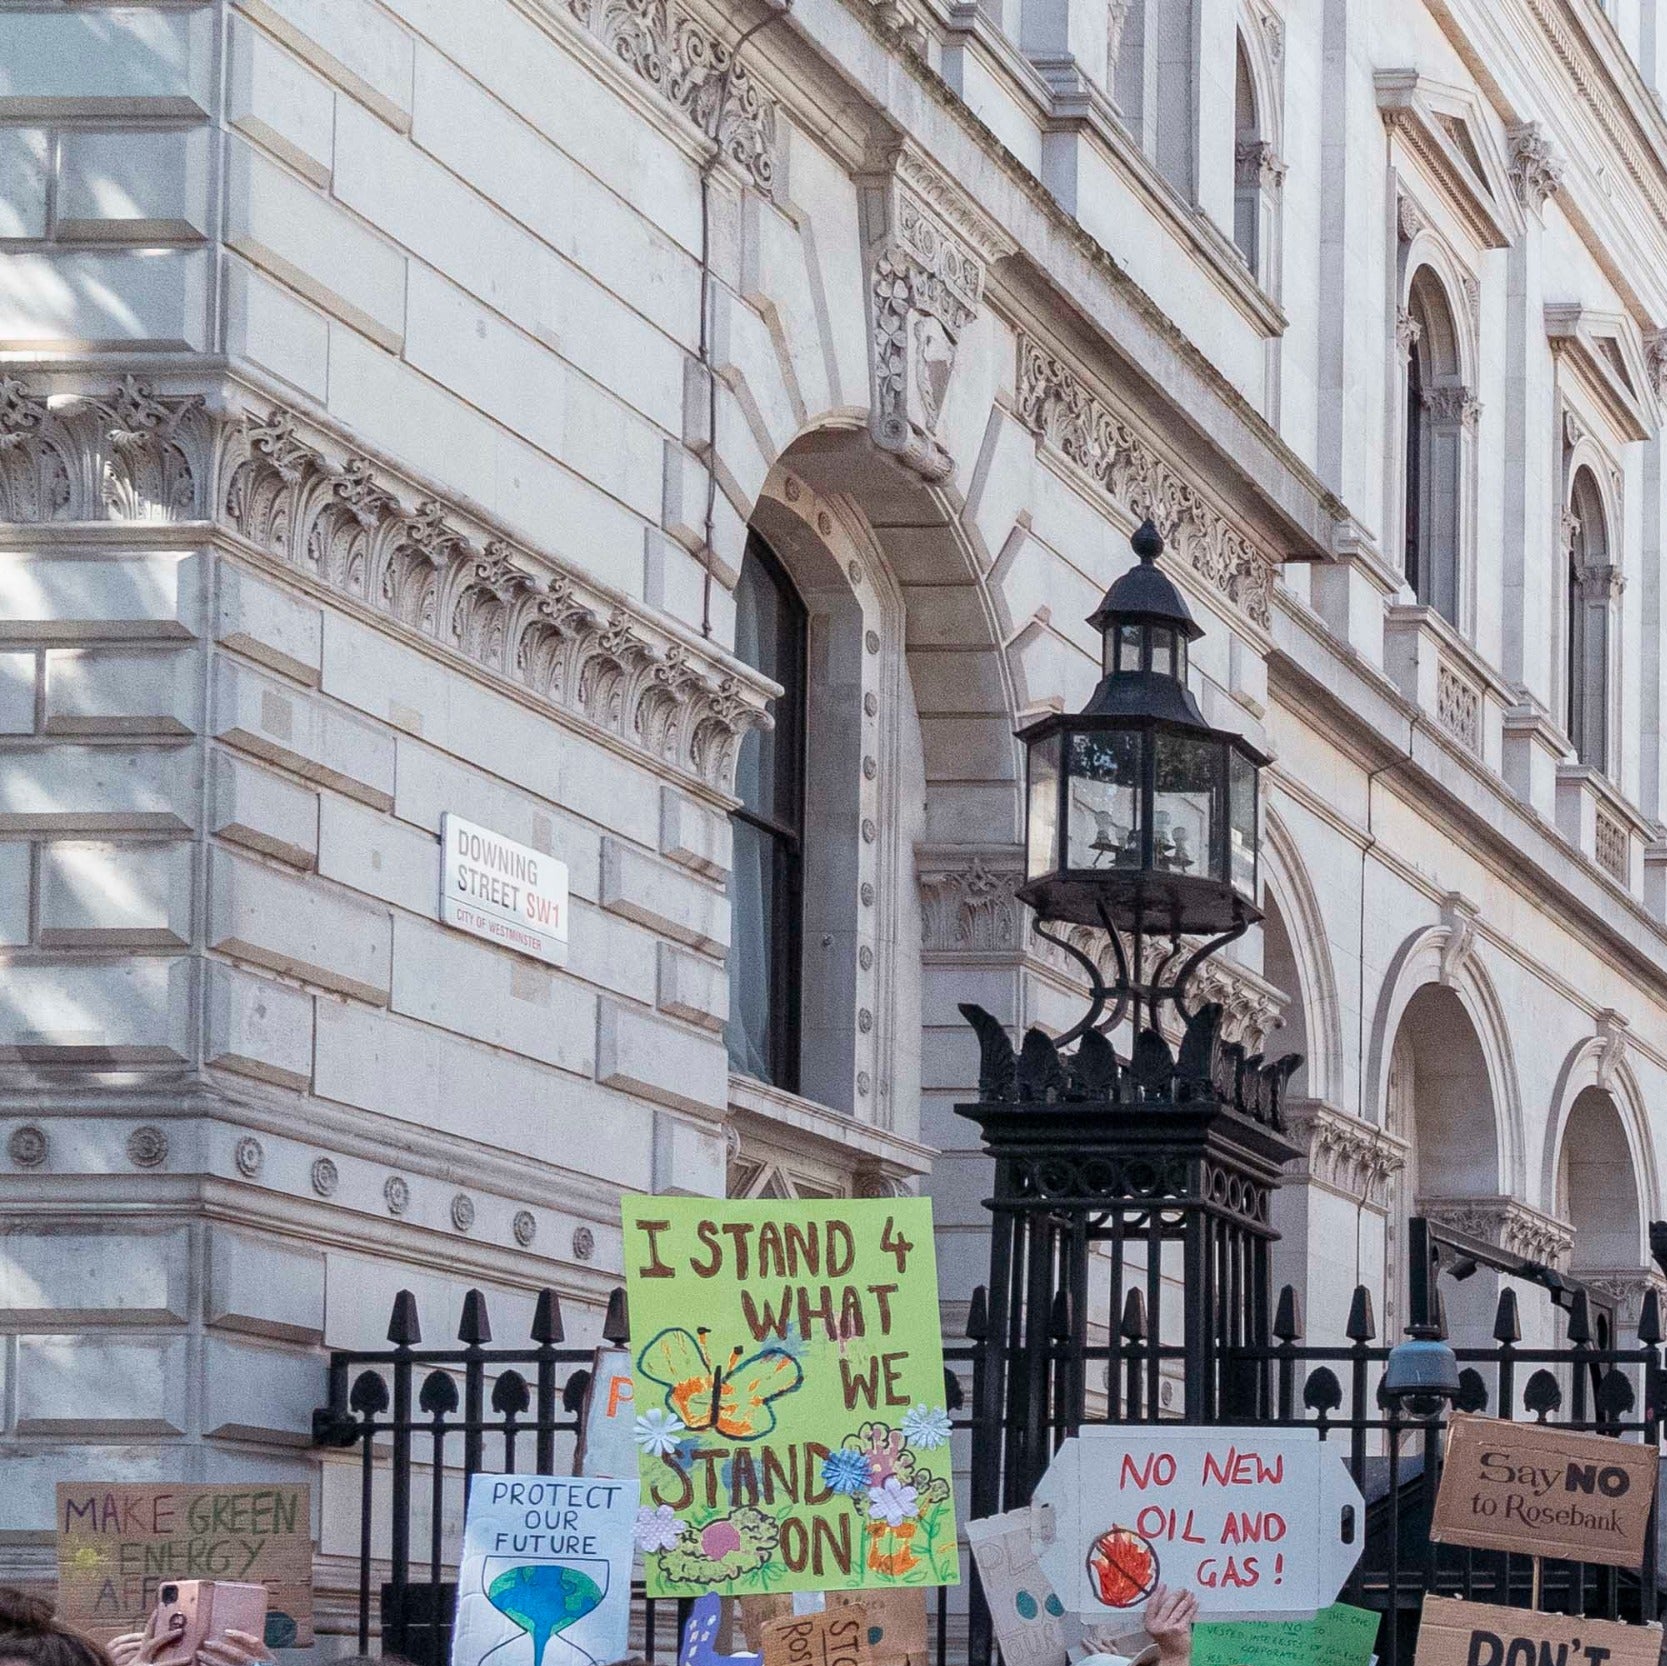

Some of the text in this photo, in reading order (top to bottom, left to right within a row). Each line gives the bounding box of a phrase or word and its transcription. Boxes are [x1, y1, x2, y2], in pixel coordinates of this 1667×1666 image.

[458, 829, 539, 887] DOWNING
[457, 864, 560, 929] STREET SW1
[456, 908, 543, 953] CITY OF WESTMINSTER
[634, 1215, 915, 1281] I STAND 4
[739, 1282, 900, 1343] WHAT
[838, 1349, 912, 1412] WE
[650, 1441, 834, 1512] STAND
[1119, 1444, 1285, 1491] NO NEW
[1477, 1451, 1631, 1499] Say NO
[64, 1490, 298, 1535] MAKE GREEN
[491, 1481, 623, 1510] PROTECT
[1471, 1491, 1629, 1539] to Rosebank
[494, 1532, 598, 1555] FUTURE
[524, 1509, 579, 1531] OUR
[1136, 1503, 1287, 1546] OIL AND
[118, 1537, 267, 1578] ENERGY
[779, 1511, 853, 1577] ON
[1281, 1620, 1303, 1633] NO
